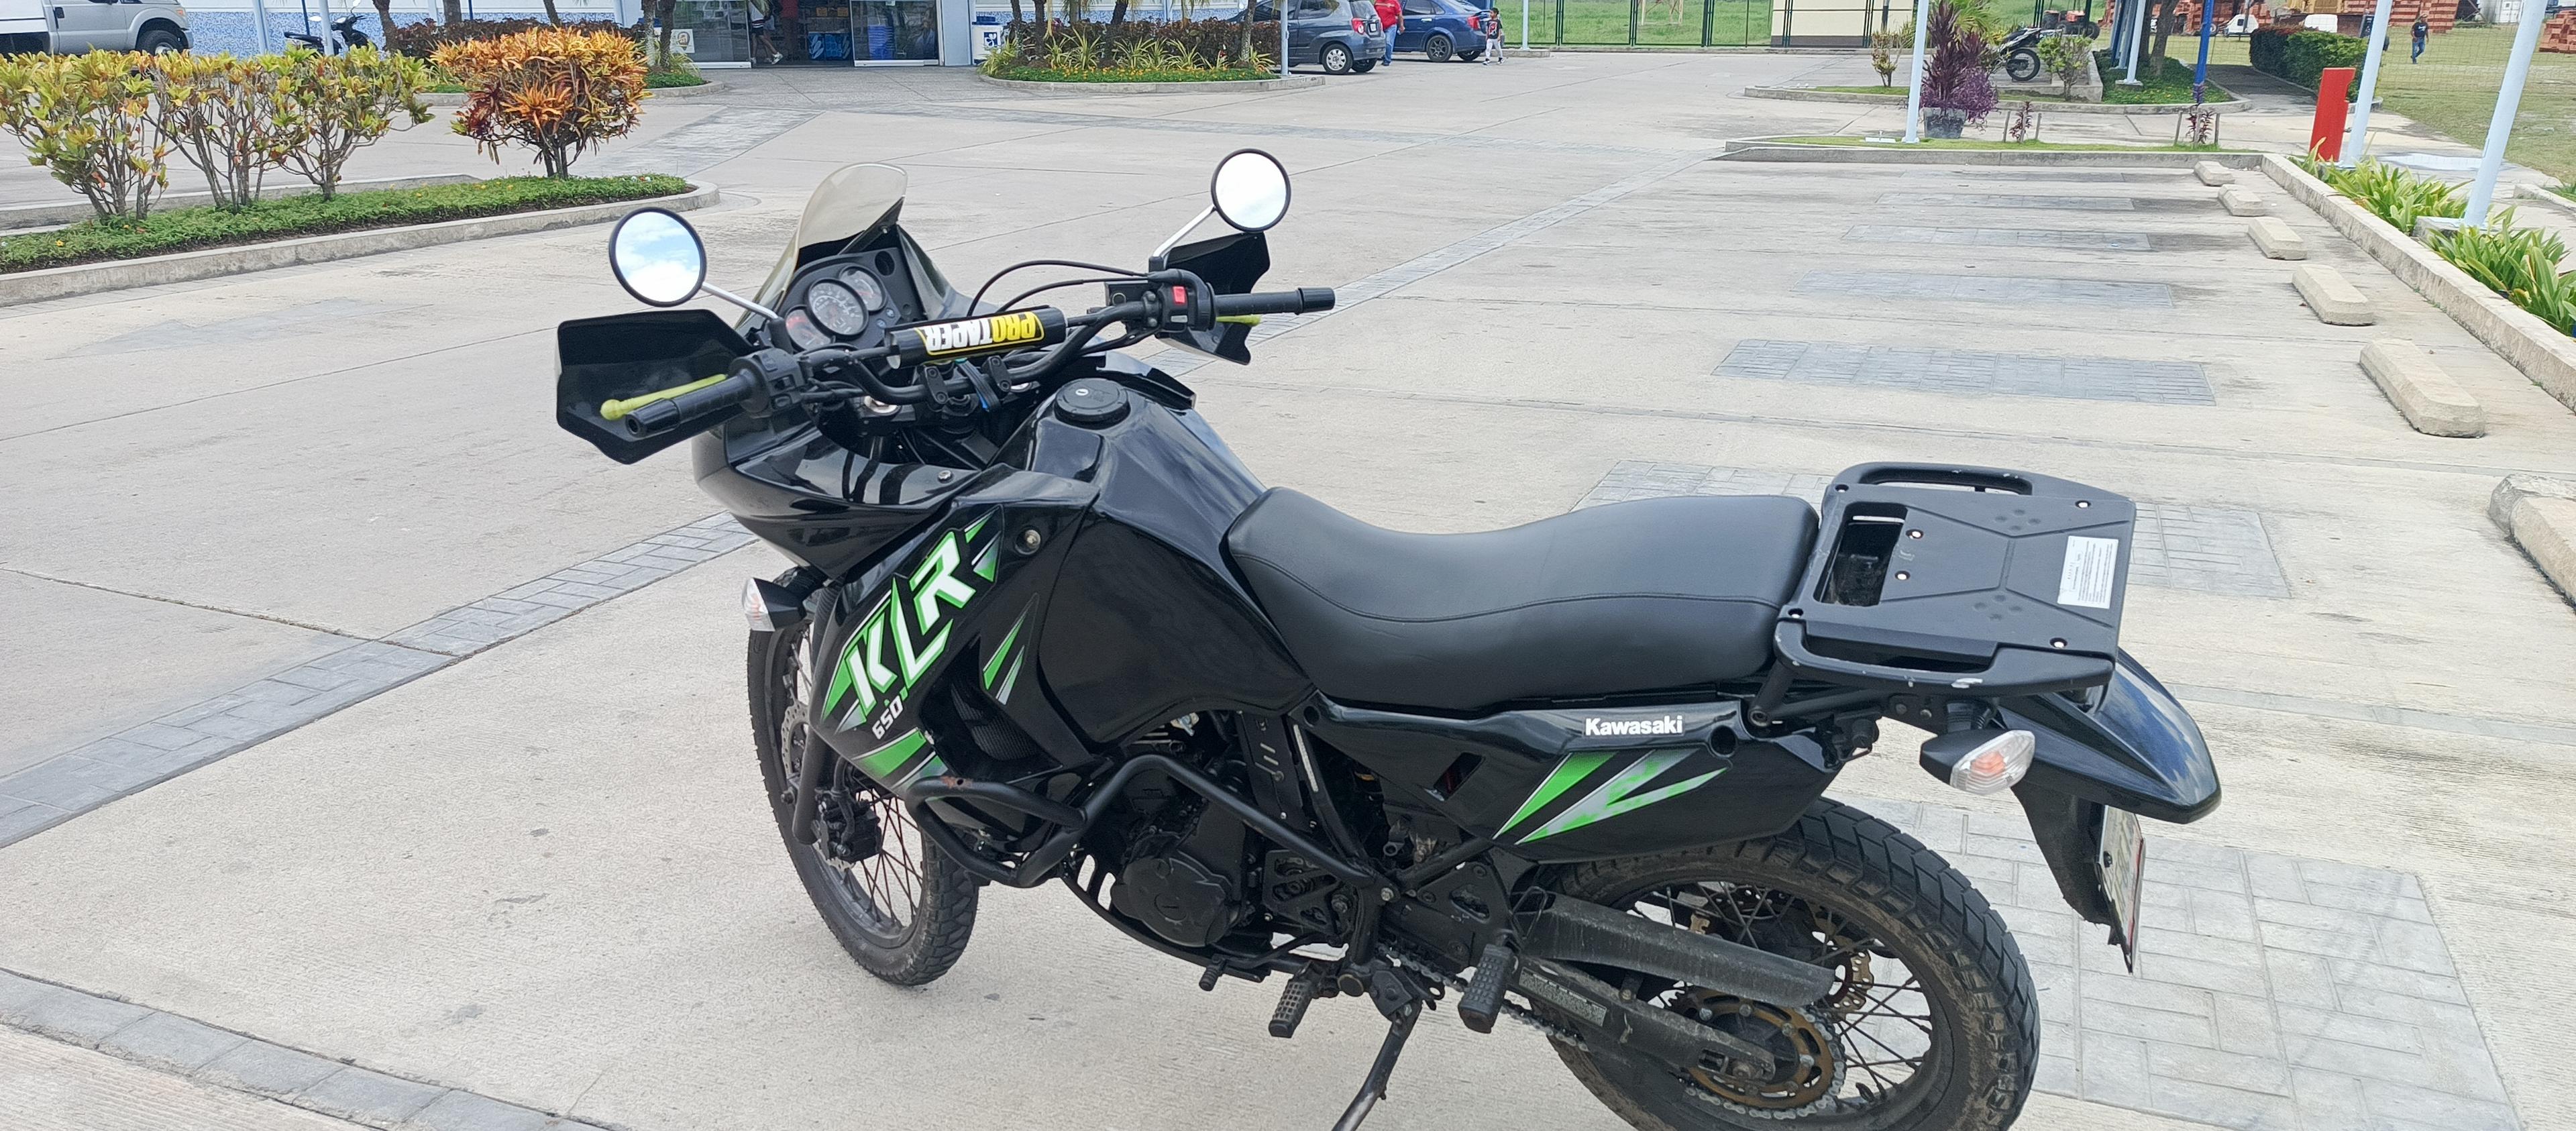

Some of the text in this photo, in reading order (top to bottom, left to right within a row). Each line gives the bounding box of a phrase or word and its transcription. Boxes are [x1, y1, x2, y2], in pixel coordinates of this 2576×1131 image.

[845, 531, 976, 716] KLR
[871, 696, 904, 739] 650
[1585, 715, 1684, 736] Kawasaki
